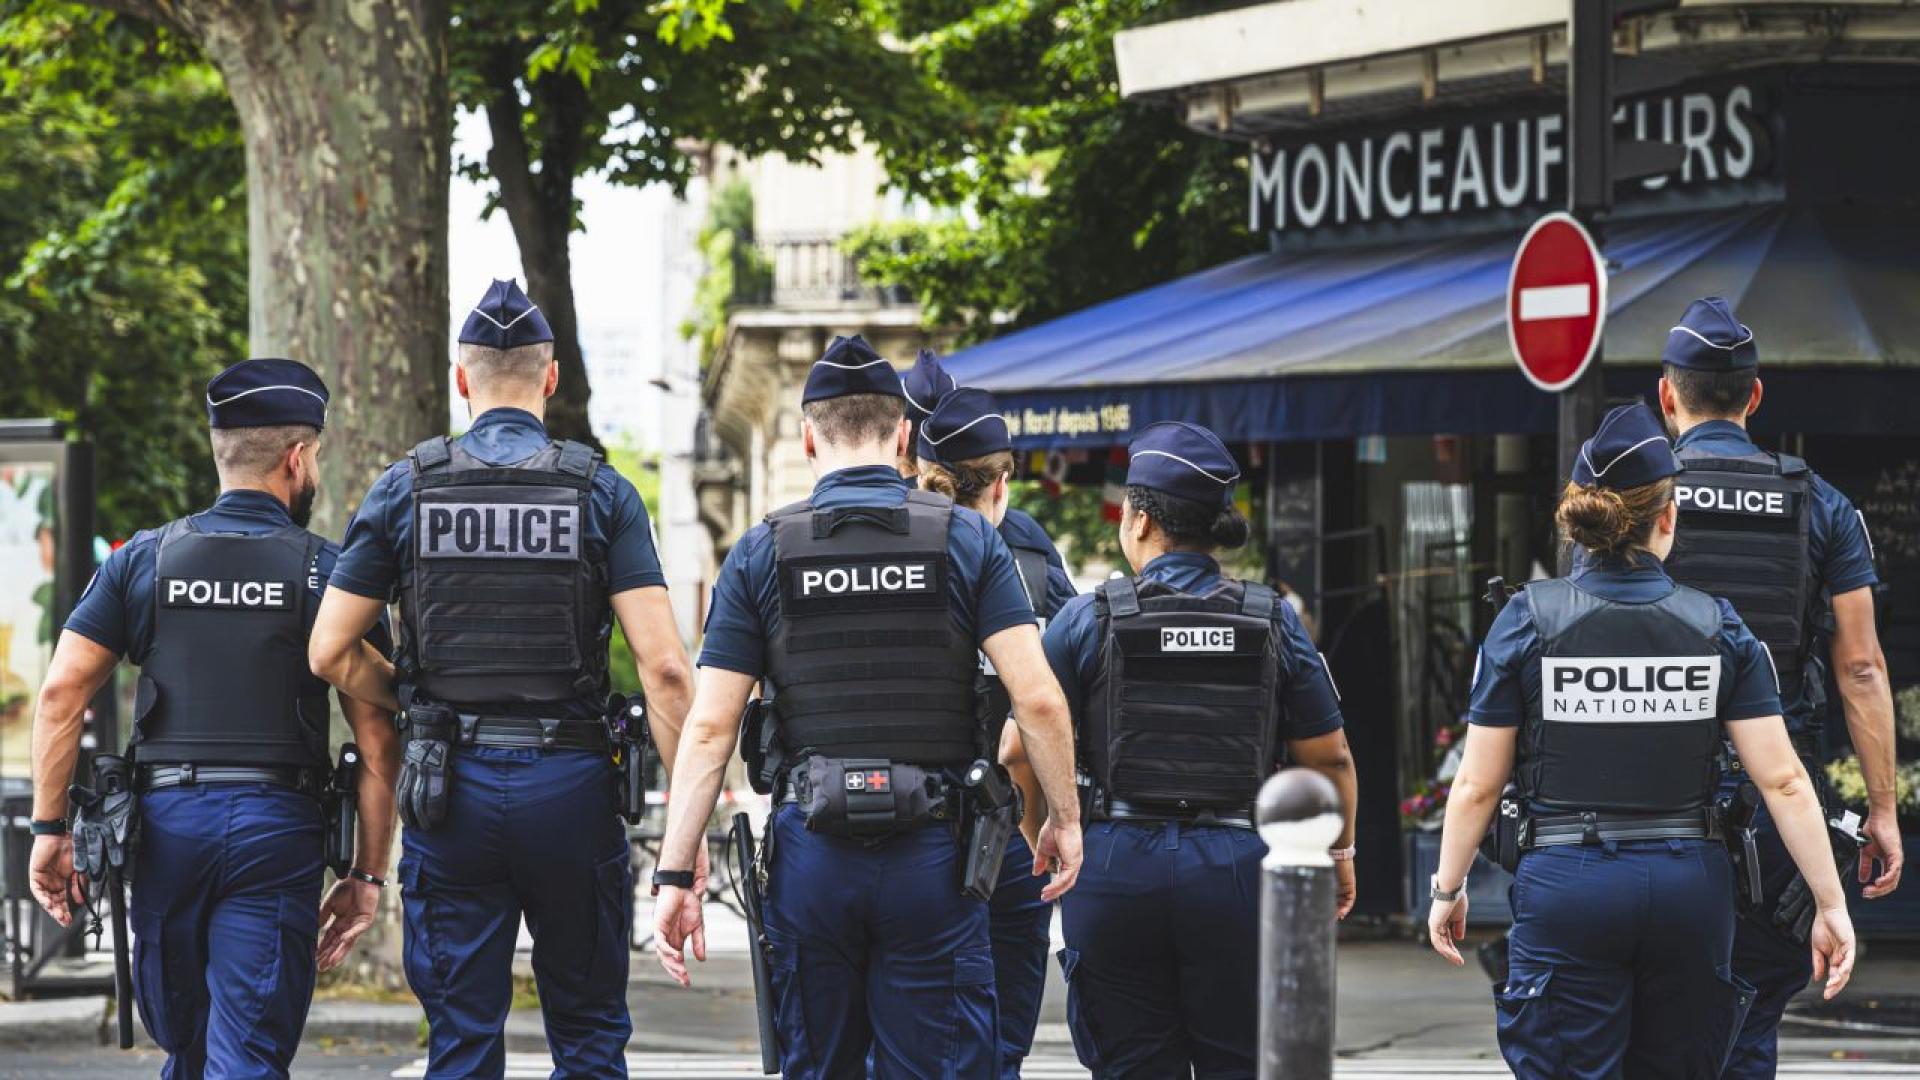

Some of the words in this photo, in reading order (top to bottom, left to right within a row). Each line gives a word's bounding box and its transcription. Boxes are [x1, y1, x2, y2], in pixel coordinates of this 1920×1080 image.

[1248, 85, 1755, 233] MONCEAUFURS
[1059, 407, 1099, 439] depuis
[1675, 487, 1783, 514] POLICE
[428, 507, 571, 553] POLICE
[168, 580, 284, 606] POLICE
[803, 565, 926, 594] POLICE
[1163, 630, 1235, 648] POLICE
[1553, 666, 1711, 692] POLICE
[1553, 698, 1710, 714] NATIONALE
